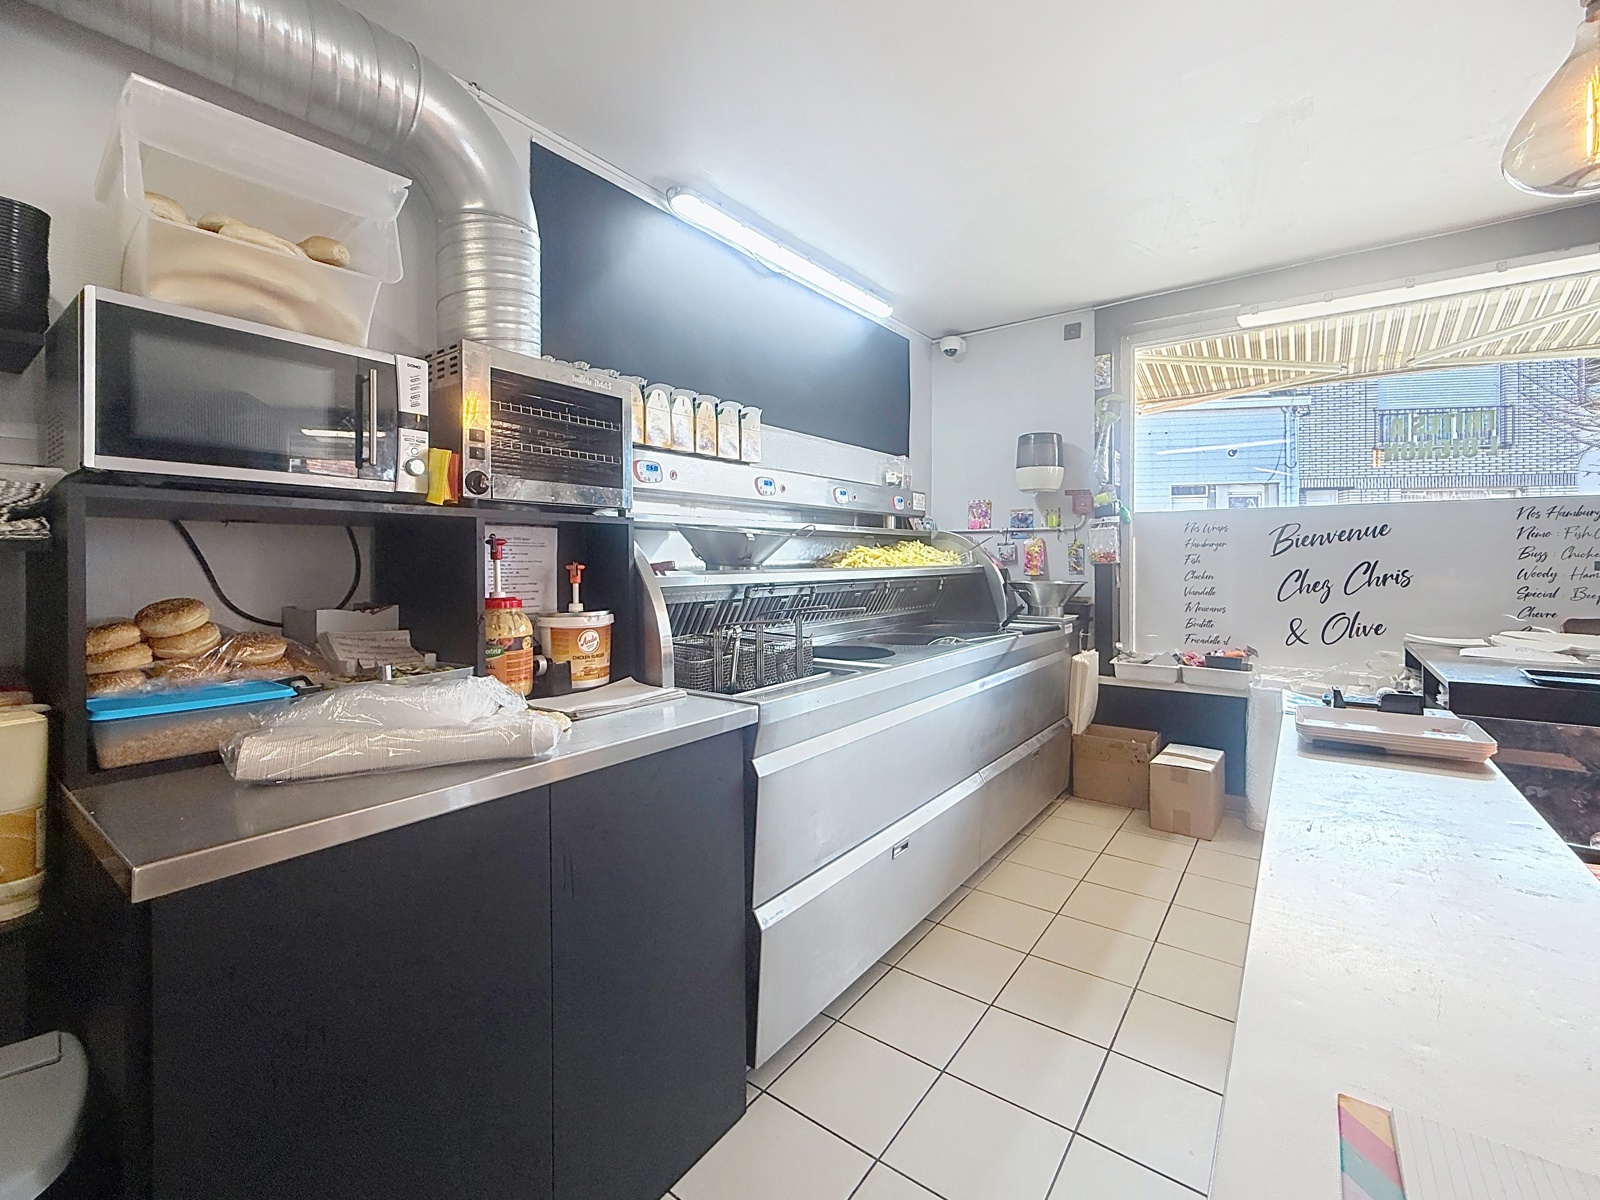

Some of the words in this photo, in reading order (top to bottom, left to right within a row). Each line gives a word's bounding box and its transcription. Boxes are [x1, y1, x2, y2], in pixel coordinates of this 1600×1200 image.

[1516, 505, 1541, 520] Nos
[1184, 538, 1227, 552] Hamburger
[1269, 522, 1392, 557] Bienvenue
[1184, 569, 1214, 582] Chicken
[1277, 568, 1334, 605] Chez
[1343, 560, 1414, 596] Chris
[1516, 565, 1558, 584] Woody
[1285, 617, 1310, 647] &
[1321, 610, 1387, 646] Olive
